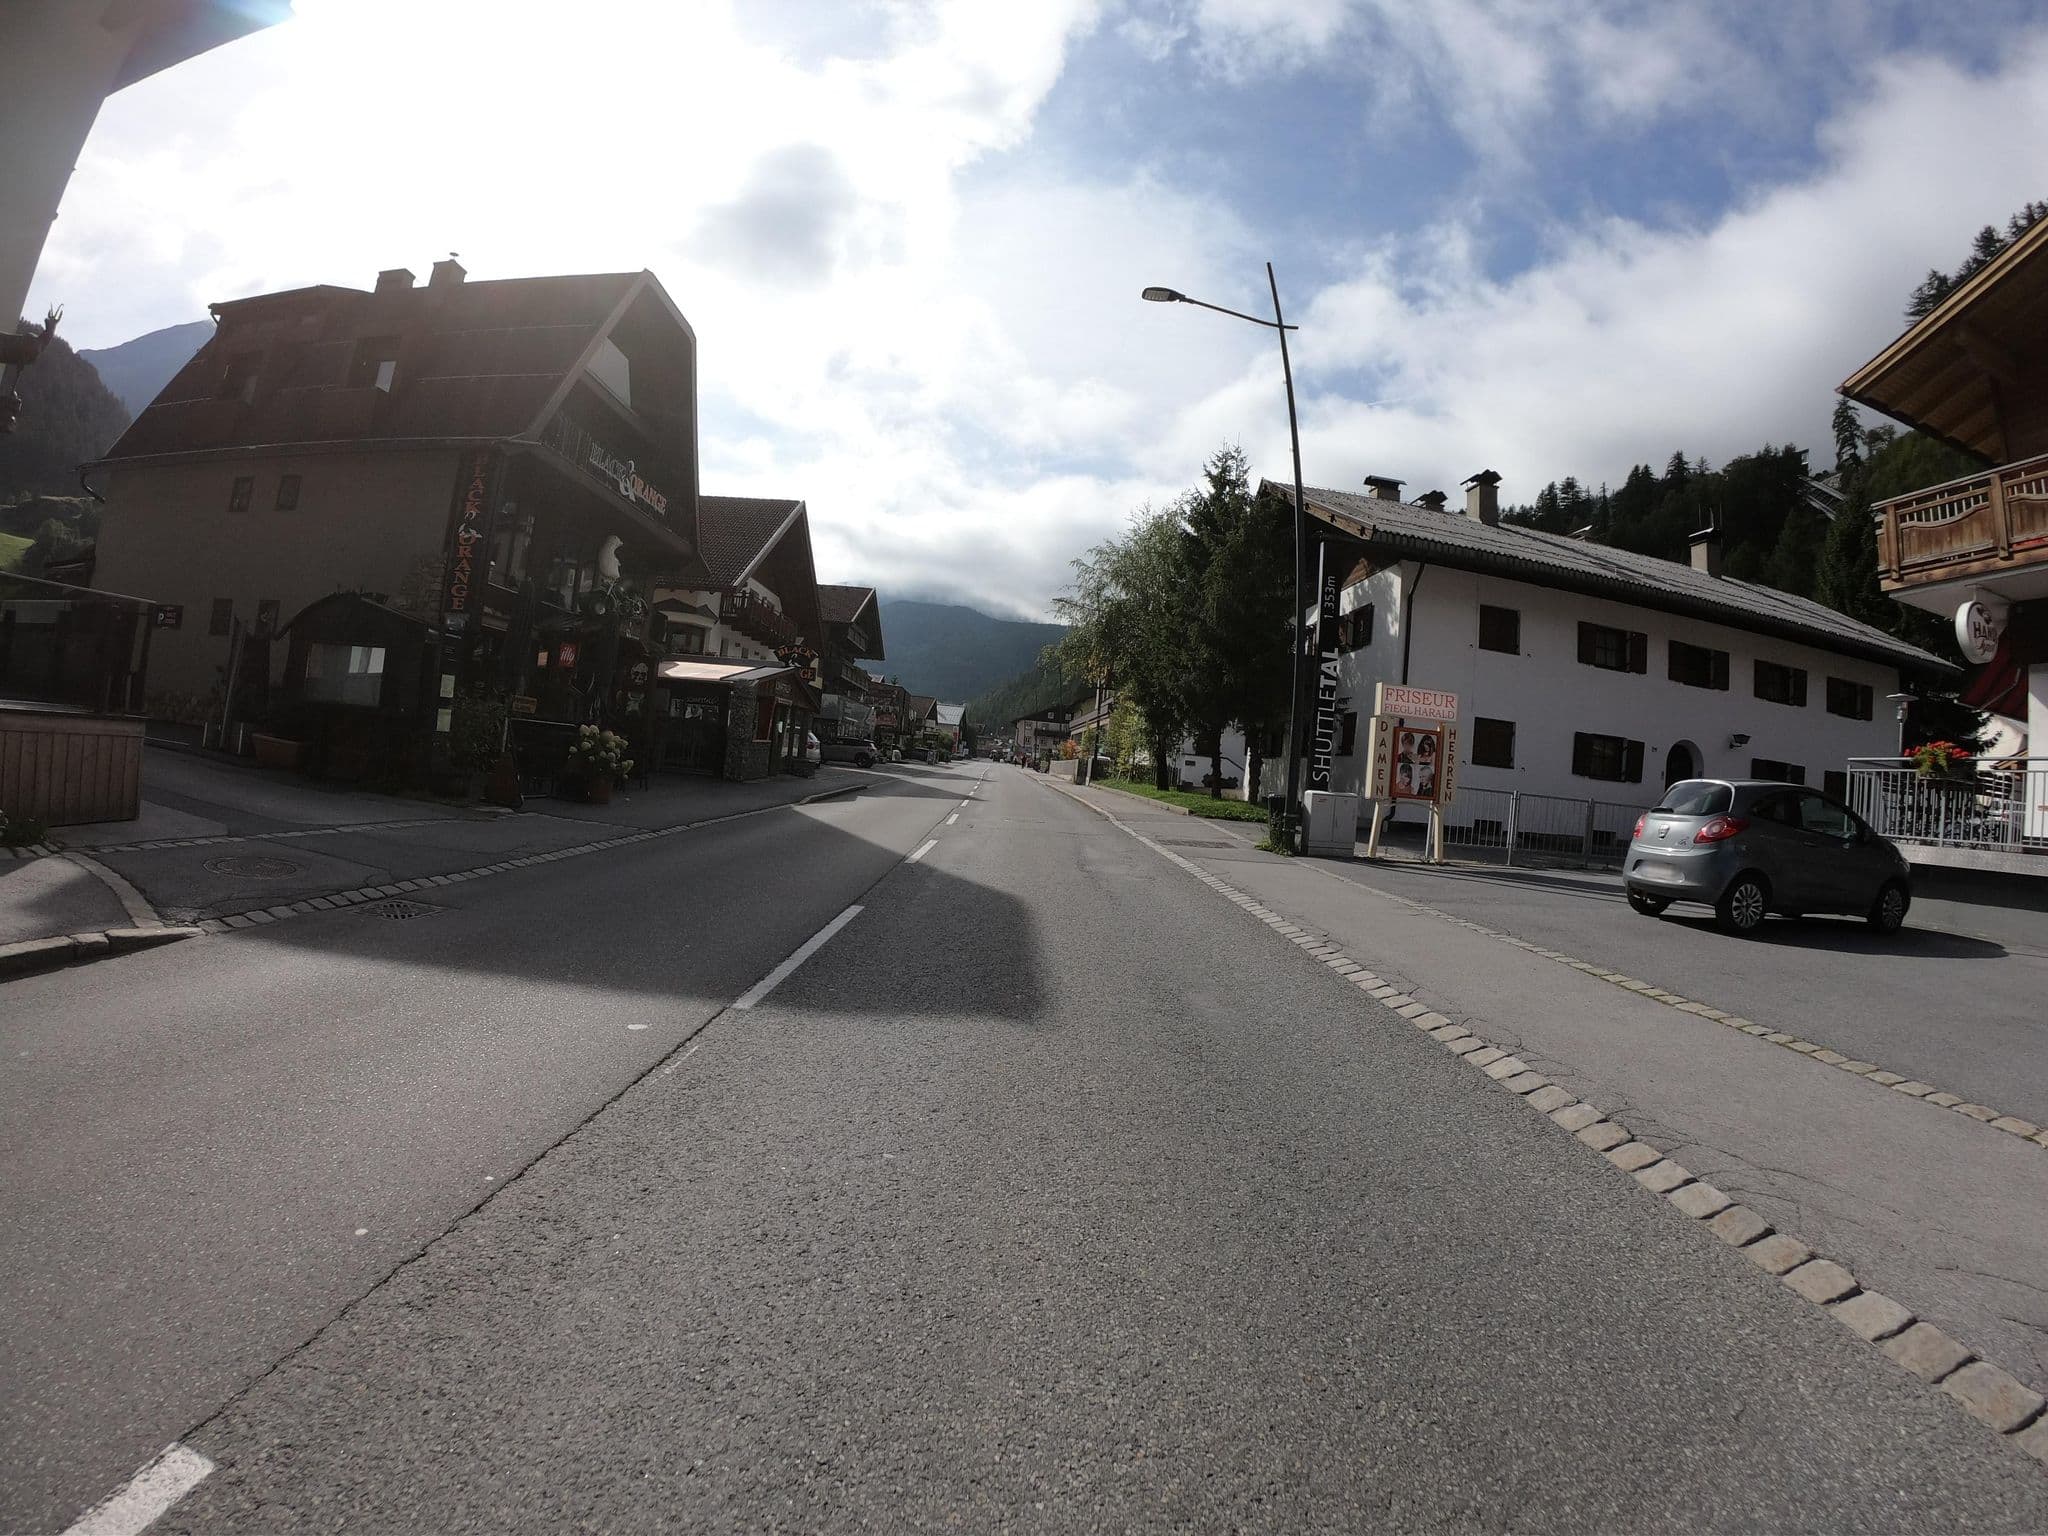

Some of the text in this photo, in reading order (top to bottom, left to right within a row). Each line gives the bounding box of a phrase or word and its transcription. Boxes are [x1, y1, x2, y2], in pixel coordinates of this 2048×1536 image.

[630, 473, 668, 516] ORANGE
[451, 535, 477, 610] ORANGE
[1323, 575, 1336, 619] 1.353m
[560, 646, 575, 665] illy
[777, 646, 813, 658] BLACK
[1313, 647, 1339, 783] SHUTTLETAL
[1384, 703, 1455, 719] FIEGL HARALD
[1385, 687, 1455, 708] FRISEUR
[1376, 720, 1388, 797] DAMEN
[1444, 728, 1457, 801] HERREN
